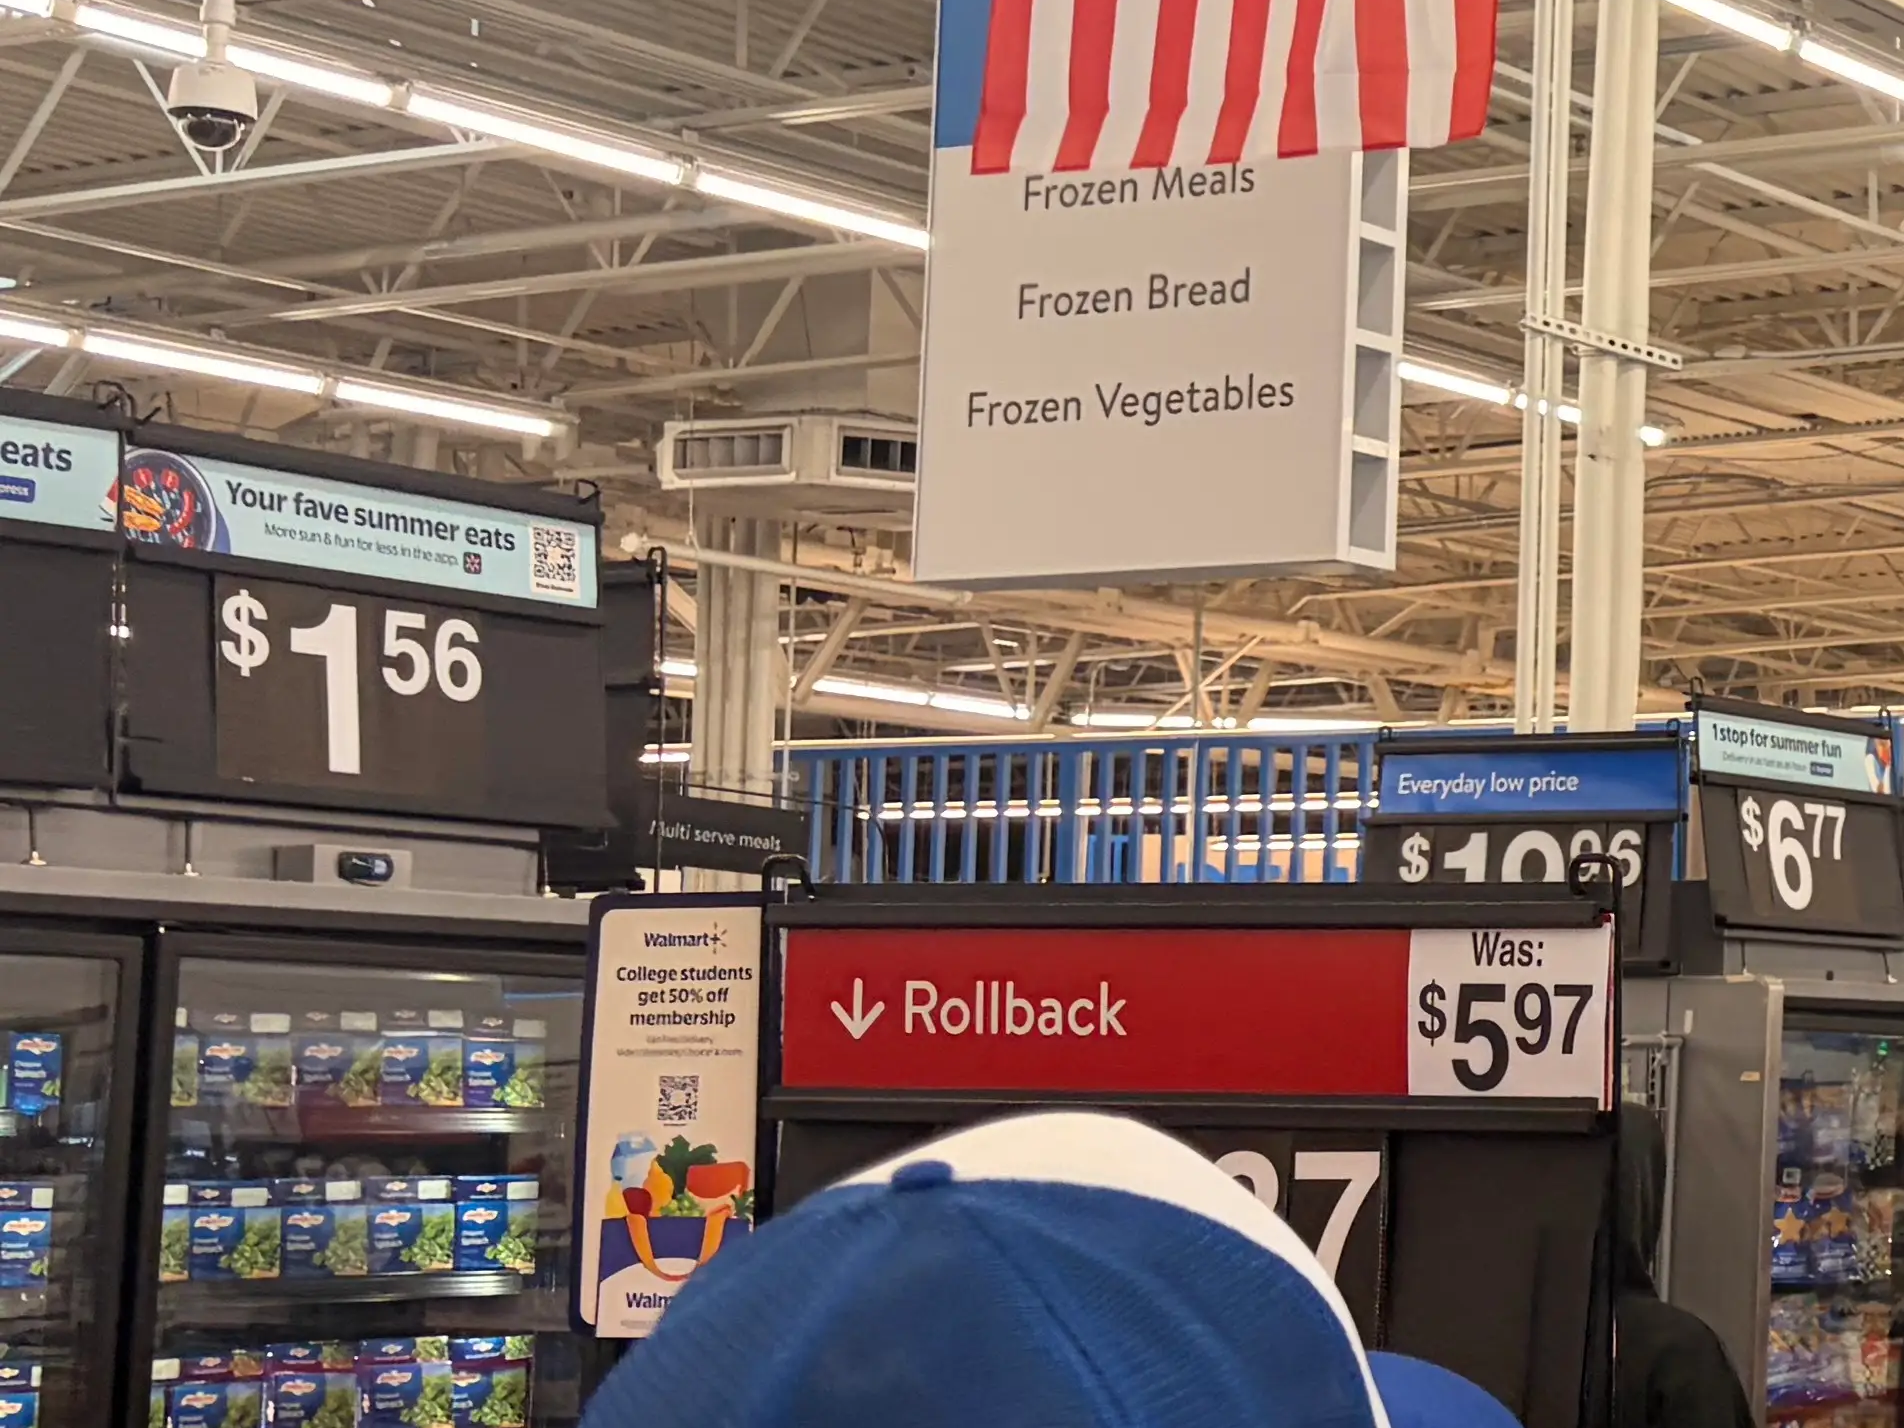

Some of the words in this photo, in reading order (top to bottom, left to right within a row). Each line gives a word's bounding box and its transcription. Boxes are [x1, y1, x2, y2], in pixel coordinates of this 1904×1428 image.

[1023, 173, 1138, 212] Frozen
[1151, 163, 1256, 202] Meals
[1018, 281, 1133, 320] Frozen
[1148, 267, 1251, 310] Bread
[967, 389, 1081, 428] Frozen
[1095, 373, 1295, 427] Vegetables
[0, 439, 73, 472] eats
[226, 479, 289, 515] Your
[294, 492, 349, 525] fave
[353, 506, 461, 544] summer
[465, 523, 516, 552] eats
[1719, 726, 1748, 749] stop
[1750, 728, 1769, 749] for
[1770, 734, 1820, 756] summer
[1821, 739, 1843, 760] fun
[1398, 772, 1485, 799] Everyday
[1490, 771, 1524, 793] low
[1528, 770, 1580, 798] price
[695, 828, 736, 848] serve
[739, 833, 782, 852] meals
[1471, 931, 1545, 968] Was:
[616, 964, 677, 984] College
[680, 964, 753, 982] students
[638, 988, 667, 1006] get
[669, 987, 704, 1005] 50%
[706, 986, 729, 1004] off
[903, 980, 1128, 1038] Rollback
[629, 1008, 736, 1029] membership
